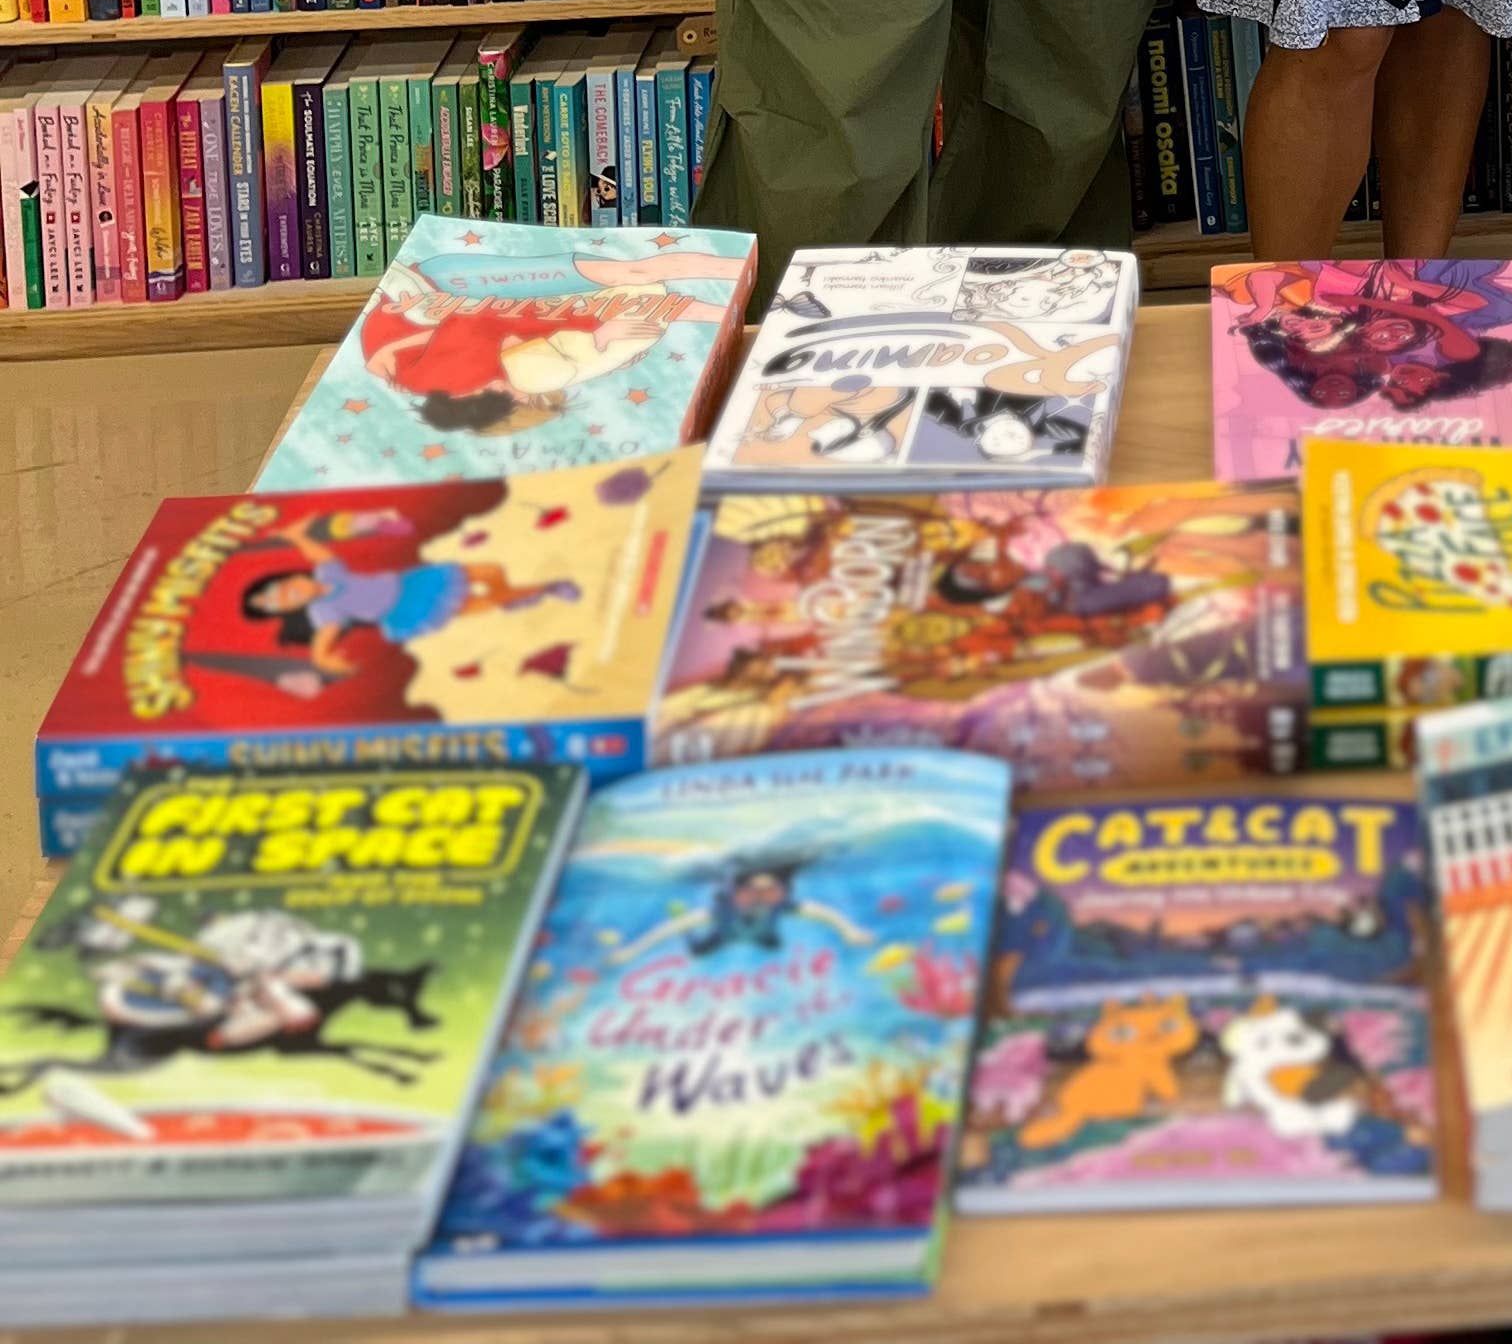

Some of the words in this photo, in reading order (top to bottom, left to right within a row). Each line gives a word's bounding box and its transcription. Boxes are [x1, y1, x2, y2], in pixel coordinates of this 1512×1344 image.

[1148, 39, 1176, 114] naomi
[1156, 122, 1179, 195] osaka
[381, 289, 696, 323] HEARTSTOPPER
[450, 277, 469, 290] 5
[139, 789, 345, 831] FIRST
[373, 784, 523, 827] CAT
[121, 838, 205, 877] IN
[254, 827, 502, 872] SPACE
[1032, 805, 1395, 886] CAT&CAT
